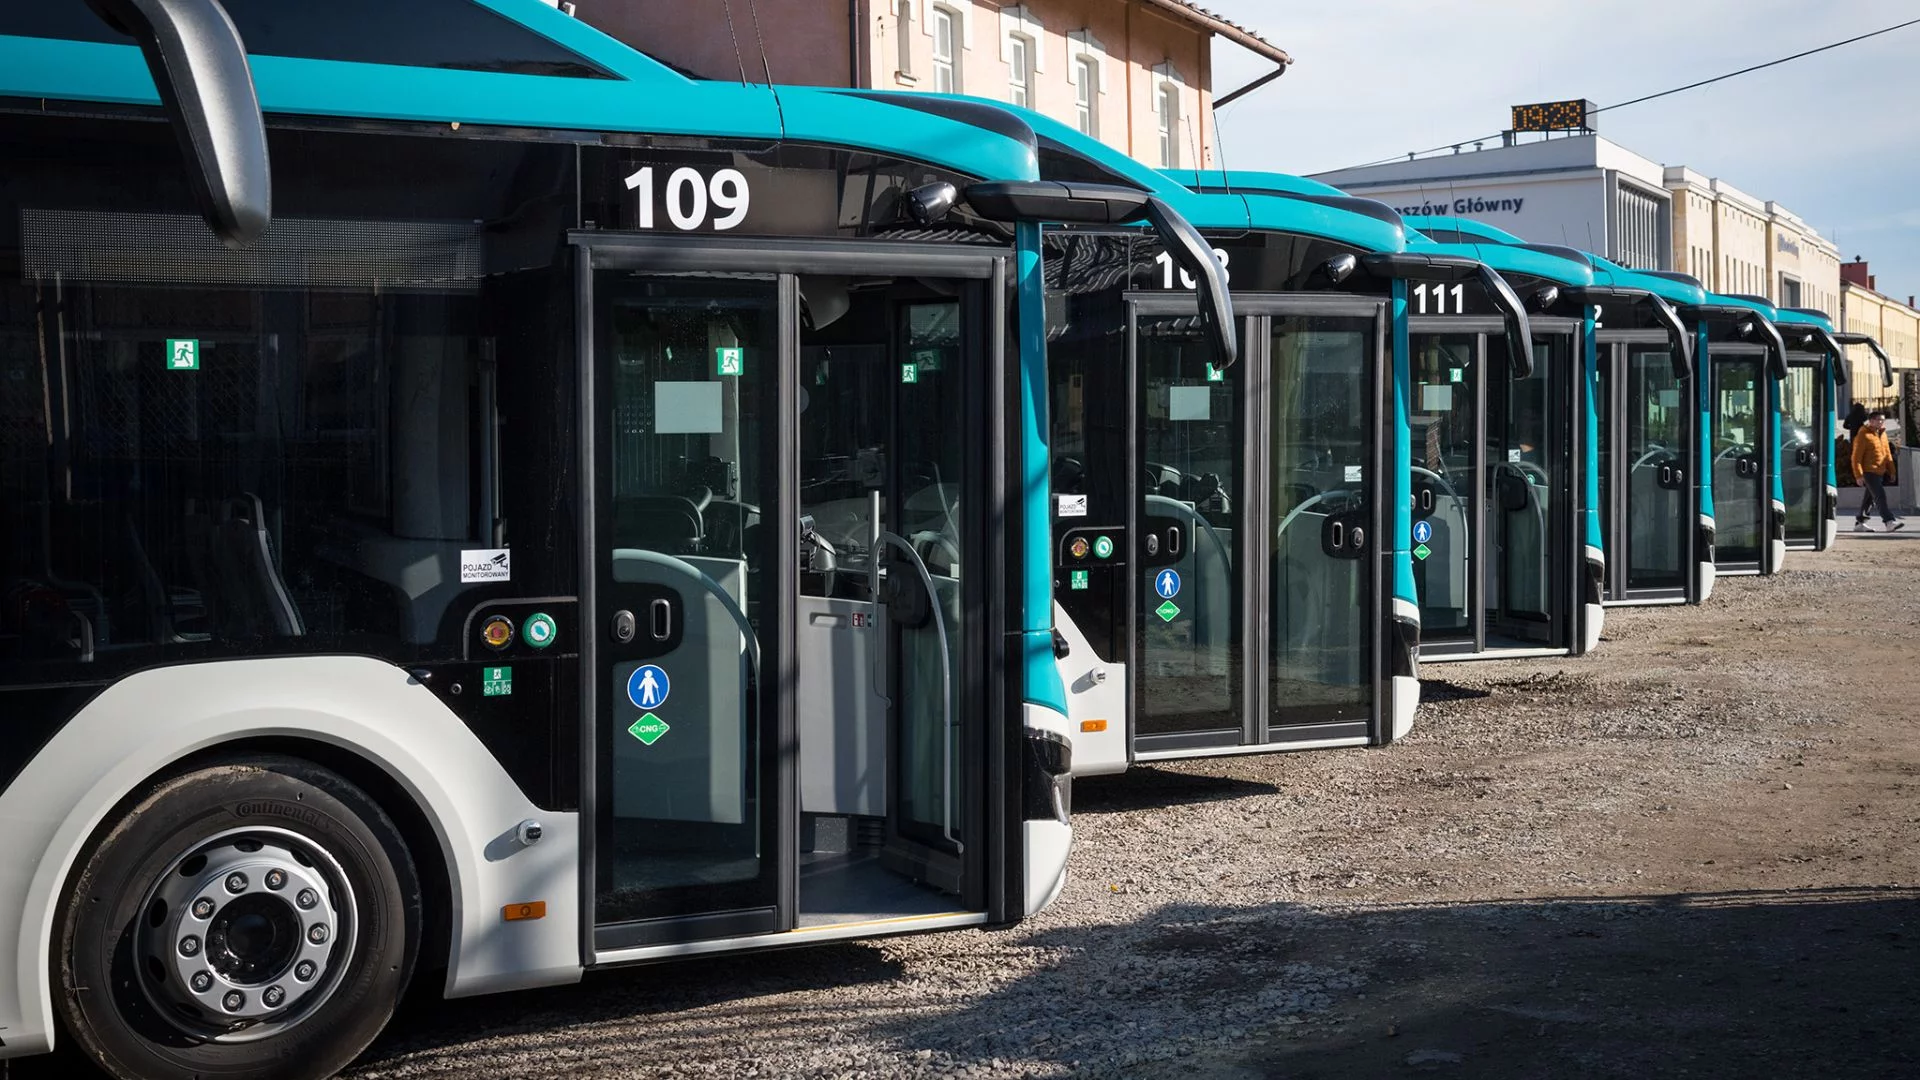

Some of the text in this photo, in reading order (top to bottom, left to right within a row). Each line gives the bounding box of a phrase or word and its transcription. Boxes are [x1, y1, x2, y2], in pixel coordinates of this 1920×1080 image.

[1513, 102, 1581, 131] 09:28
[624, 166, 750, 231] 109
[1453, 196, 1523, 214] Główny
[1413, 283, 1463, 314] 111
[463, 563, 493, 572] POJAZD
[463, 571, 509, 579] MONITOROWANY
[639, 724, 659, 733] CNG
[235, 801, 321, 826] Continental
